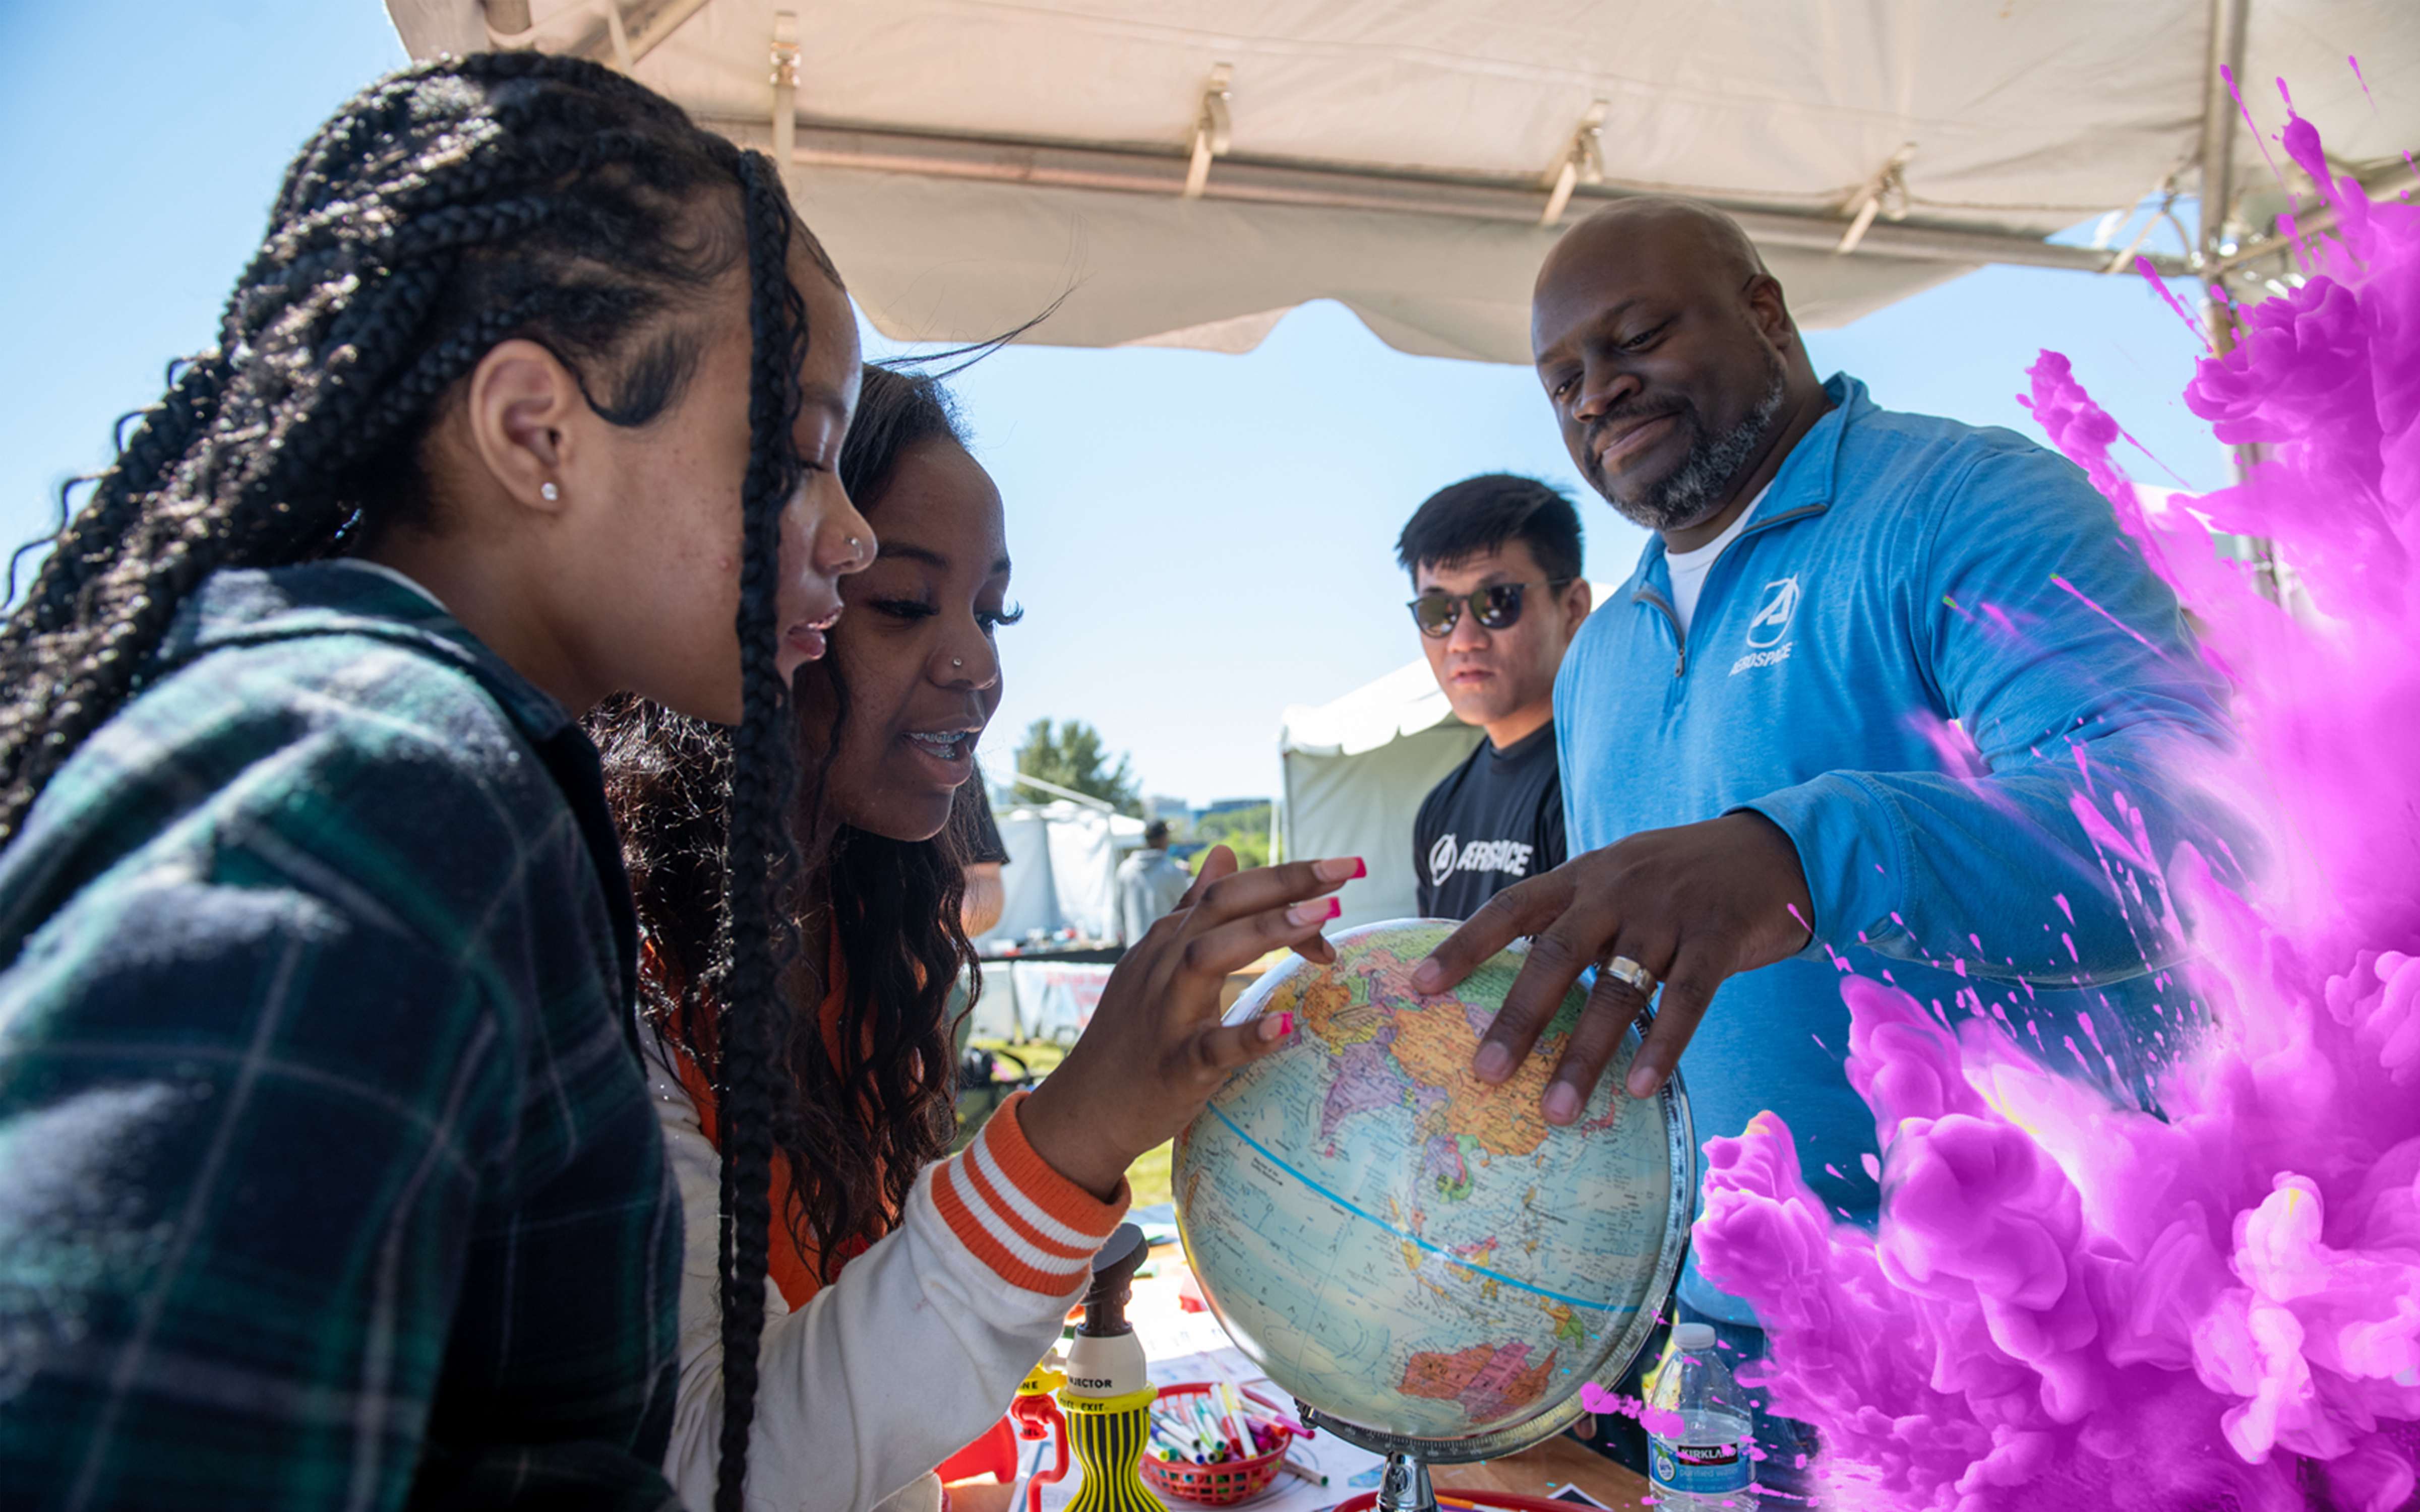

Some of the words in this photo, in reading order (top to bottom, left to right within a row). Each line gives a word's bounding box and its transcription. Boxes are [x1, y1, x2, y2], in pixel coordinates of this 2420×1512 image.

[1728, 642, 1793, 677] AEROSPACE
[1069, 1376, 1112, 1388] NJECTOR
[1081, 1403, 1104, 1411] EXIT
[1680, 1447, 1736, 1459] KIRKLAD
